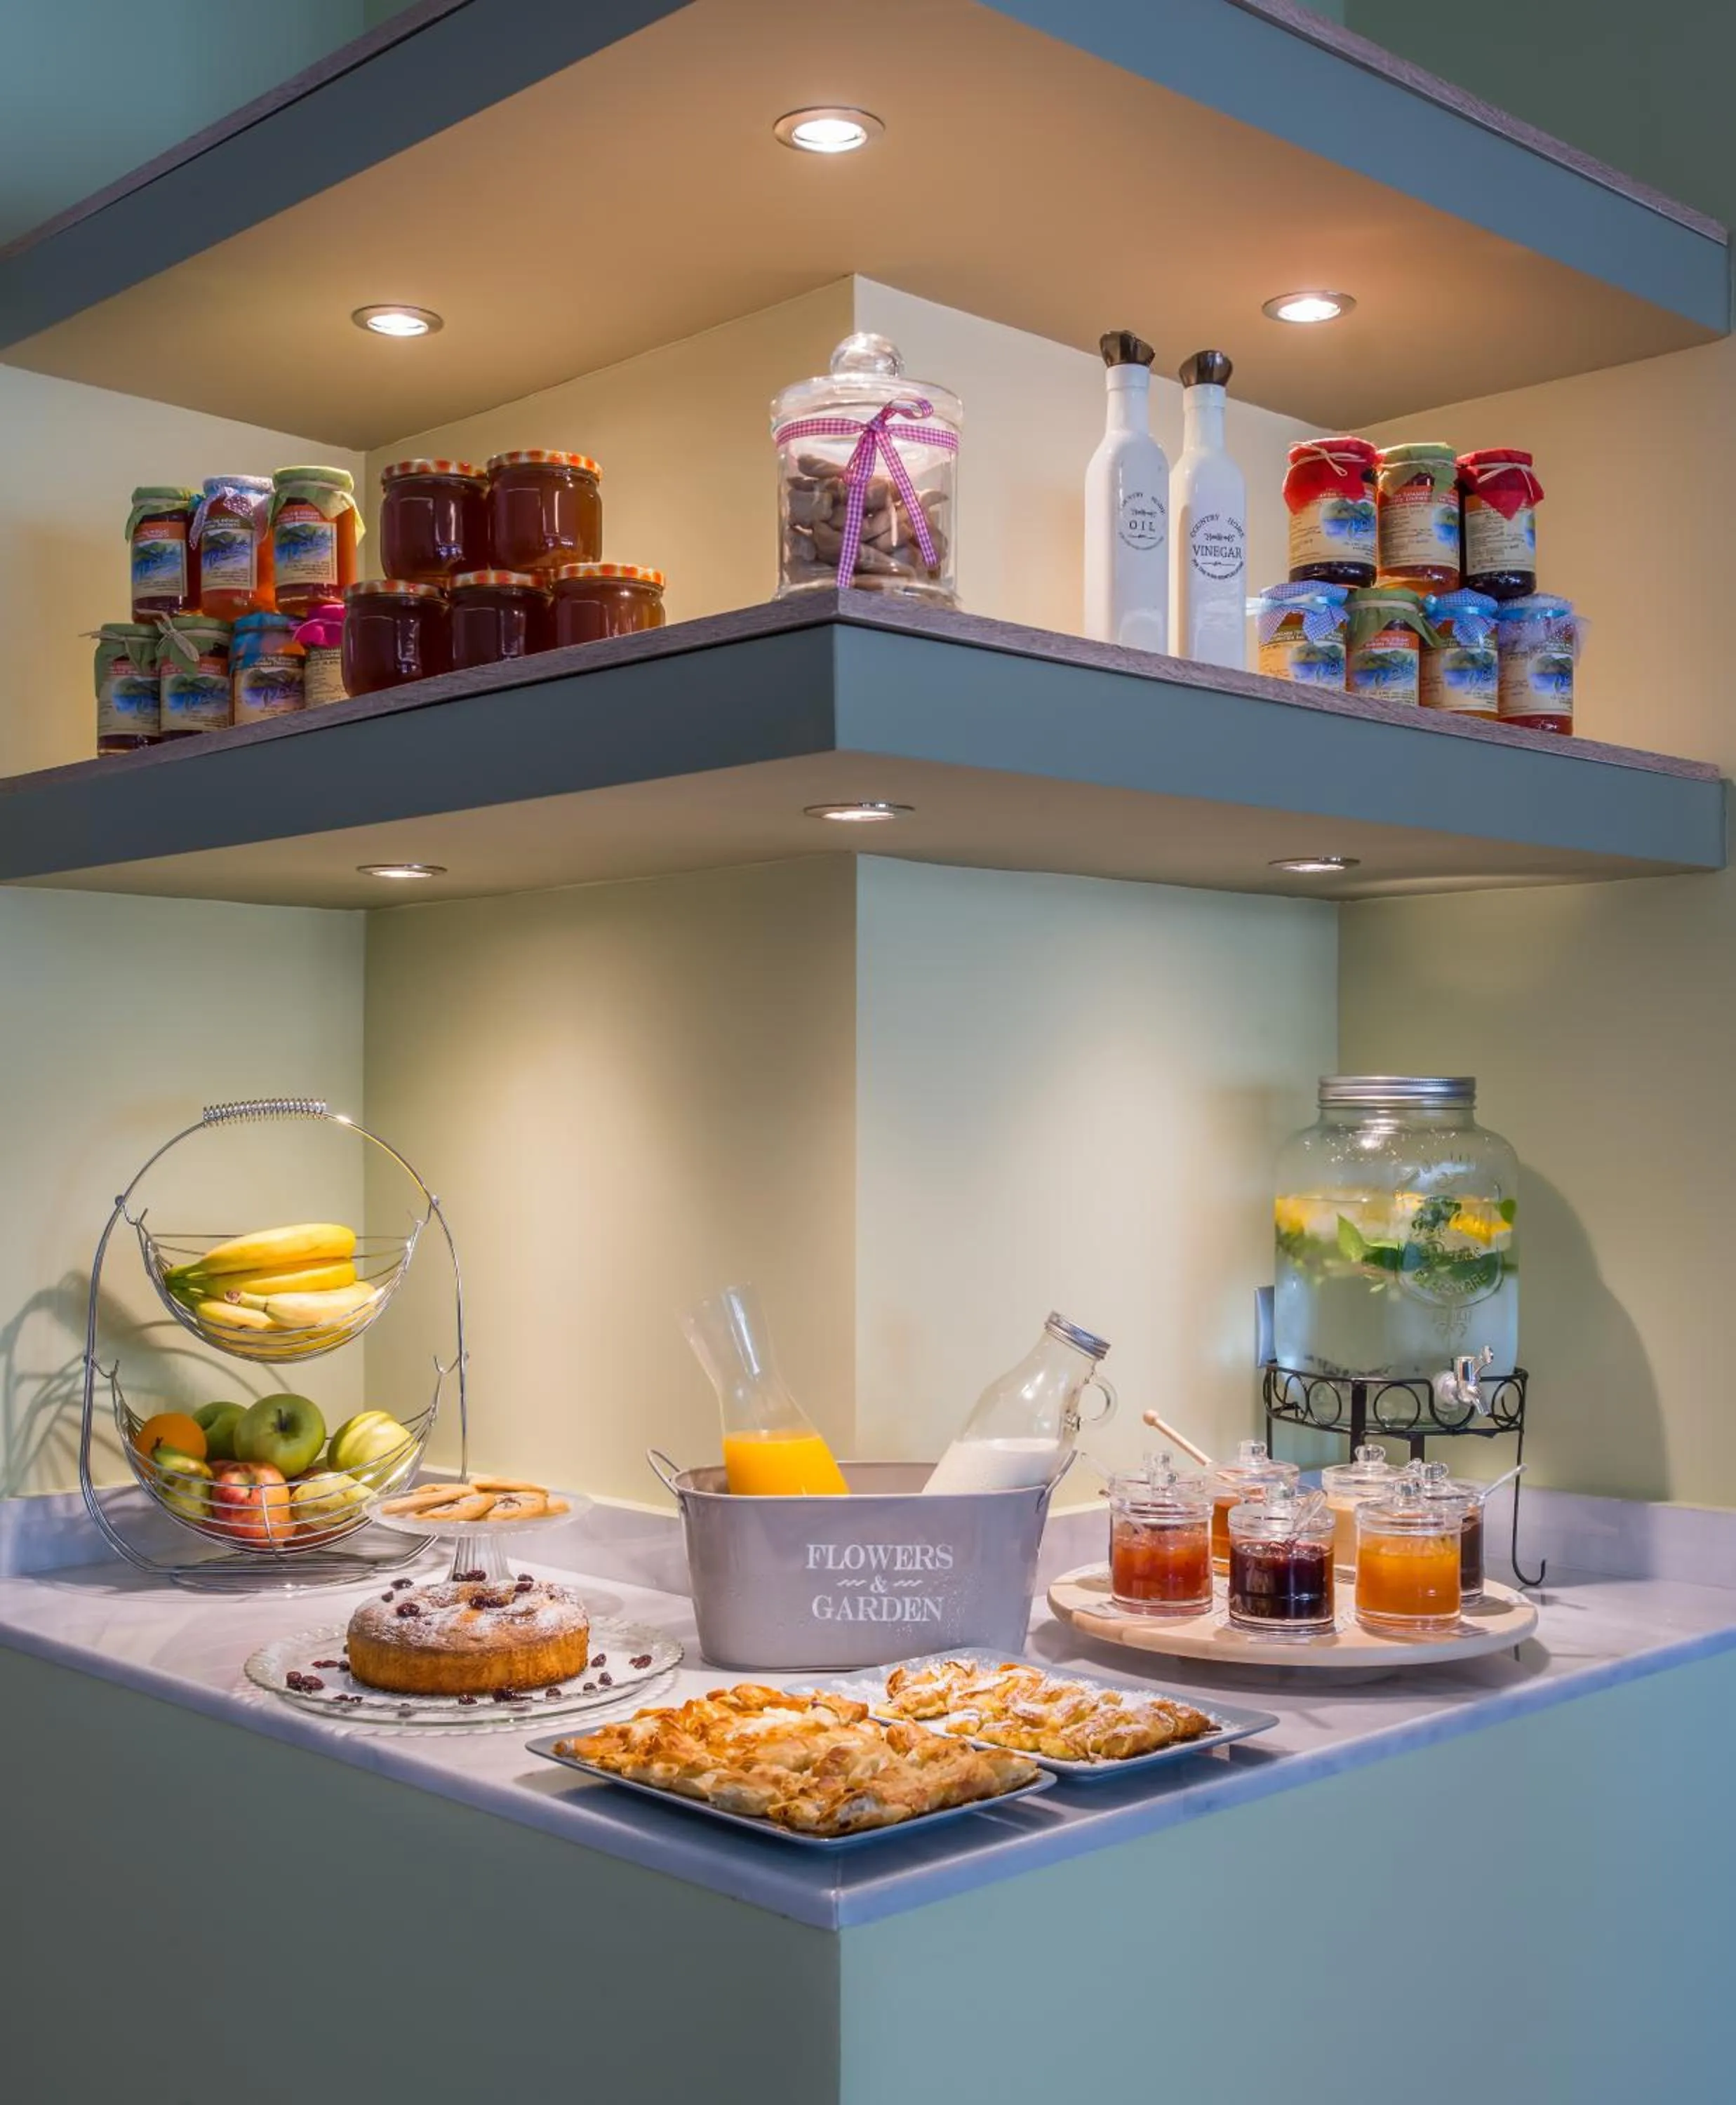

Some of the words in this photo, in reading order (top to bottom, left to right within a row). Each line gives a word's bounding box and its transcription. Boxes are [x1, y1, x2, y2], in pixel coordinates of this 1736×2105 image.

[1129, 520, 1156, 533] OIL
[1192, 544, 1243, 559] VINEGAR
[806, 1543, 954, 1570] FLOWERS
[869, 1574, 888, 1593] &
[811, 1594, 944, 1622] GARDEN
